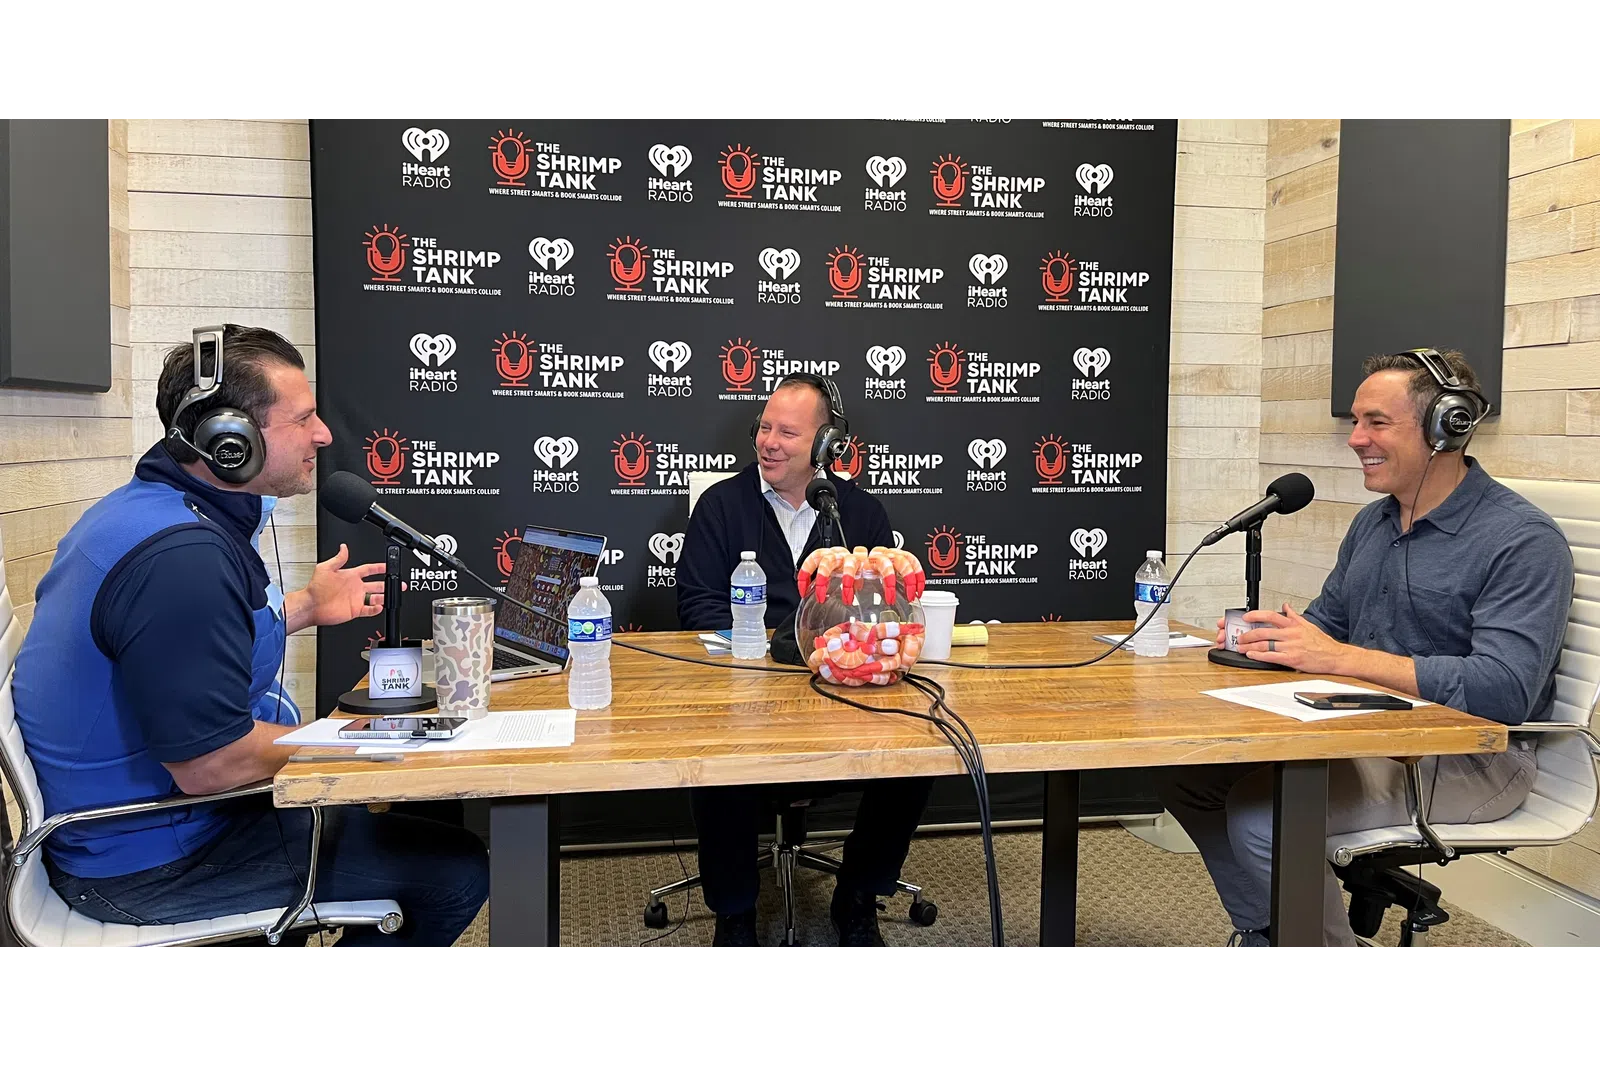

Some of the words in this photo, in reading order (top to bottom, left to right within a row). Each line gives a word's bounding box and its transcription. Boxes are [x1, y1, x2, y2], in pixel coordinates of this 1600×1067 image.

[536, 143, 560, 153] THE
[537, 154, 622, 173] SHRIMP
[762, 157, 784, 166] THE
[403, 162, 450, 177] iHeart
[971, 166, 992, 175] THE
[403, 176, 450, 188] RADIO
[536, 171, 596, 190] TANK
[763, 167, 841, 185] SHRIMP
[649, 177, 692, 191] iHeart
[972, 176, 1045, 192] SHRIMP
[649, 190, 693, 202] RADIO
[762, 184, 817, 202] TANK
[866, 188, 906, 200] iHeart
[865, 200, 906, 211] RADIO
[971, 192, 1022, 208] TANK
[1075, 195, 1112, 206] iHeart
[1074, 207, 1112, 217] RADIO
[412, 238, 436, 248] THE
[413, 248, 500, 267] SHRIMP
[652, 249, 675, 259] THE
[868, 257, 889, 266] THE
[1079, 262, 1098, 270] THE
[653, 260, 734, 277] SHRIMP
[412, 266, 474, 284] TANK
[529, 271, 574, 284] iHeart
[868, 267, 944, 283] SHRIMP
[1079, 272, 1149, 286] SHRIMP
[529, 284, 575, 296] RADIO
[652, 277, 709, 294] TANK
[759, 280, 800, 293] iHeart
[968, 286, 1007, 297] iHeart
[868, 284, 920, 300] TANK
[1078, 288, 1127, 302] TANK
[758, 293, 800, 304] RADIO
[968, 298, 1007, 308] RADIO
[539, 344, 563, 353] THE
[762, 350, 784, 359] THE
[540, 354, 624, 371] SHRIMP
[968, 353, 988, 361] THE
[410, 368, 456, 380] iHeart
[763, 360, 840, 376] SHRIMP
[968, 362, 1040, 377] SHRIMP
[540, 372, 598, 388] TANK
[648, 374, 691, 386] iHeart
[866, 377, 906, 388] iHeart
[967, 379, 1018, 393] TANK
[1072, 379, 1110, 389] iHeart
[410, 381, 457, 392] RADIO
[648, 386, 692, 397] RADIO
[865, 389, 906, 399] RADIO
[1072, 390, 1110, 400] RADIO
[412, 441, 436, 450] THE
[656, 444, 678, 452] THE
[868, 445, 889, 453] THE
[1072, 444, 1091, 452] THE
[412, 452, 500, 467] SHRIMP
[656, 454, 736, 469] SHRIMP
[869, 454, 943, 469] SHRIMP
[1072, 454, 1142, 468] SHRIMP
[412, 469, 473, 485] TANK
[534, 470, 578, 481] iHeart
[868, 471, 920, 485] TANK
[968, 470, 1006, 480] iHeart
[1072, 470, 1120, 484] TANK
[534, 482, 579, 492] RADIO
[967, 481, 1006, 491] RADIO
[965, 536, 985, 544] THE
[966, 544, 1038, 559] SHRIMP
[965, 561, 1015, 575] TANK
[1070, 559, 1107, 569] iHeart
[411, 568, 457, 579] iHeart
[648, 566, 676, 576] iHea
[1069, 570, 1107, 579] RADIO
[410, 580, 457, 590] RADIO
[648, 577, 676, 587] RAD
